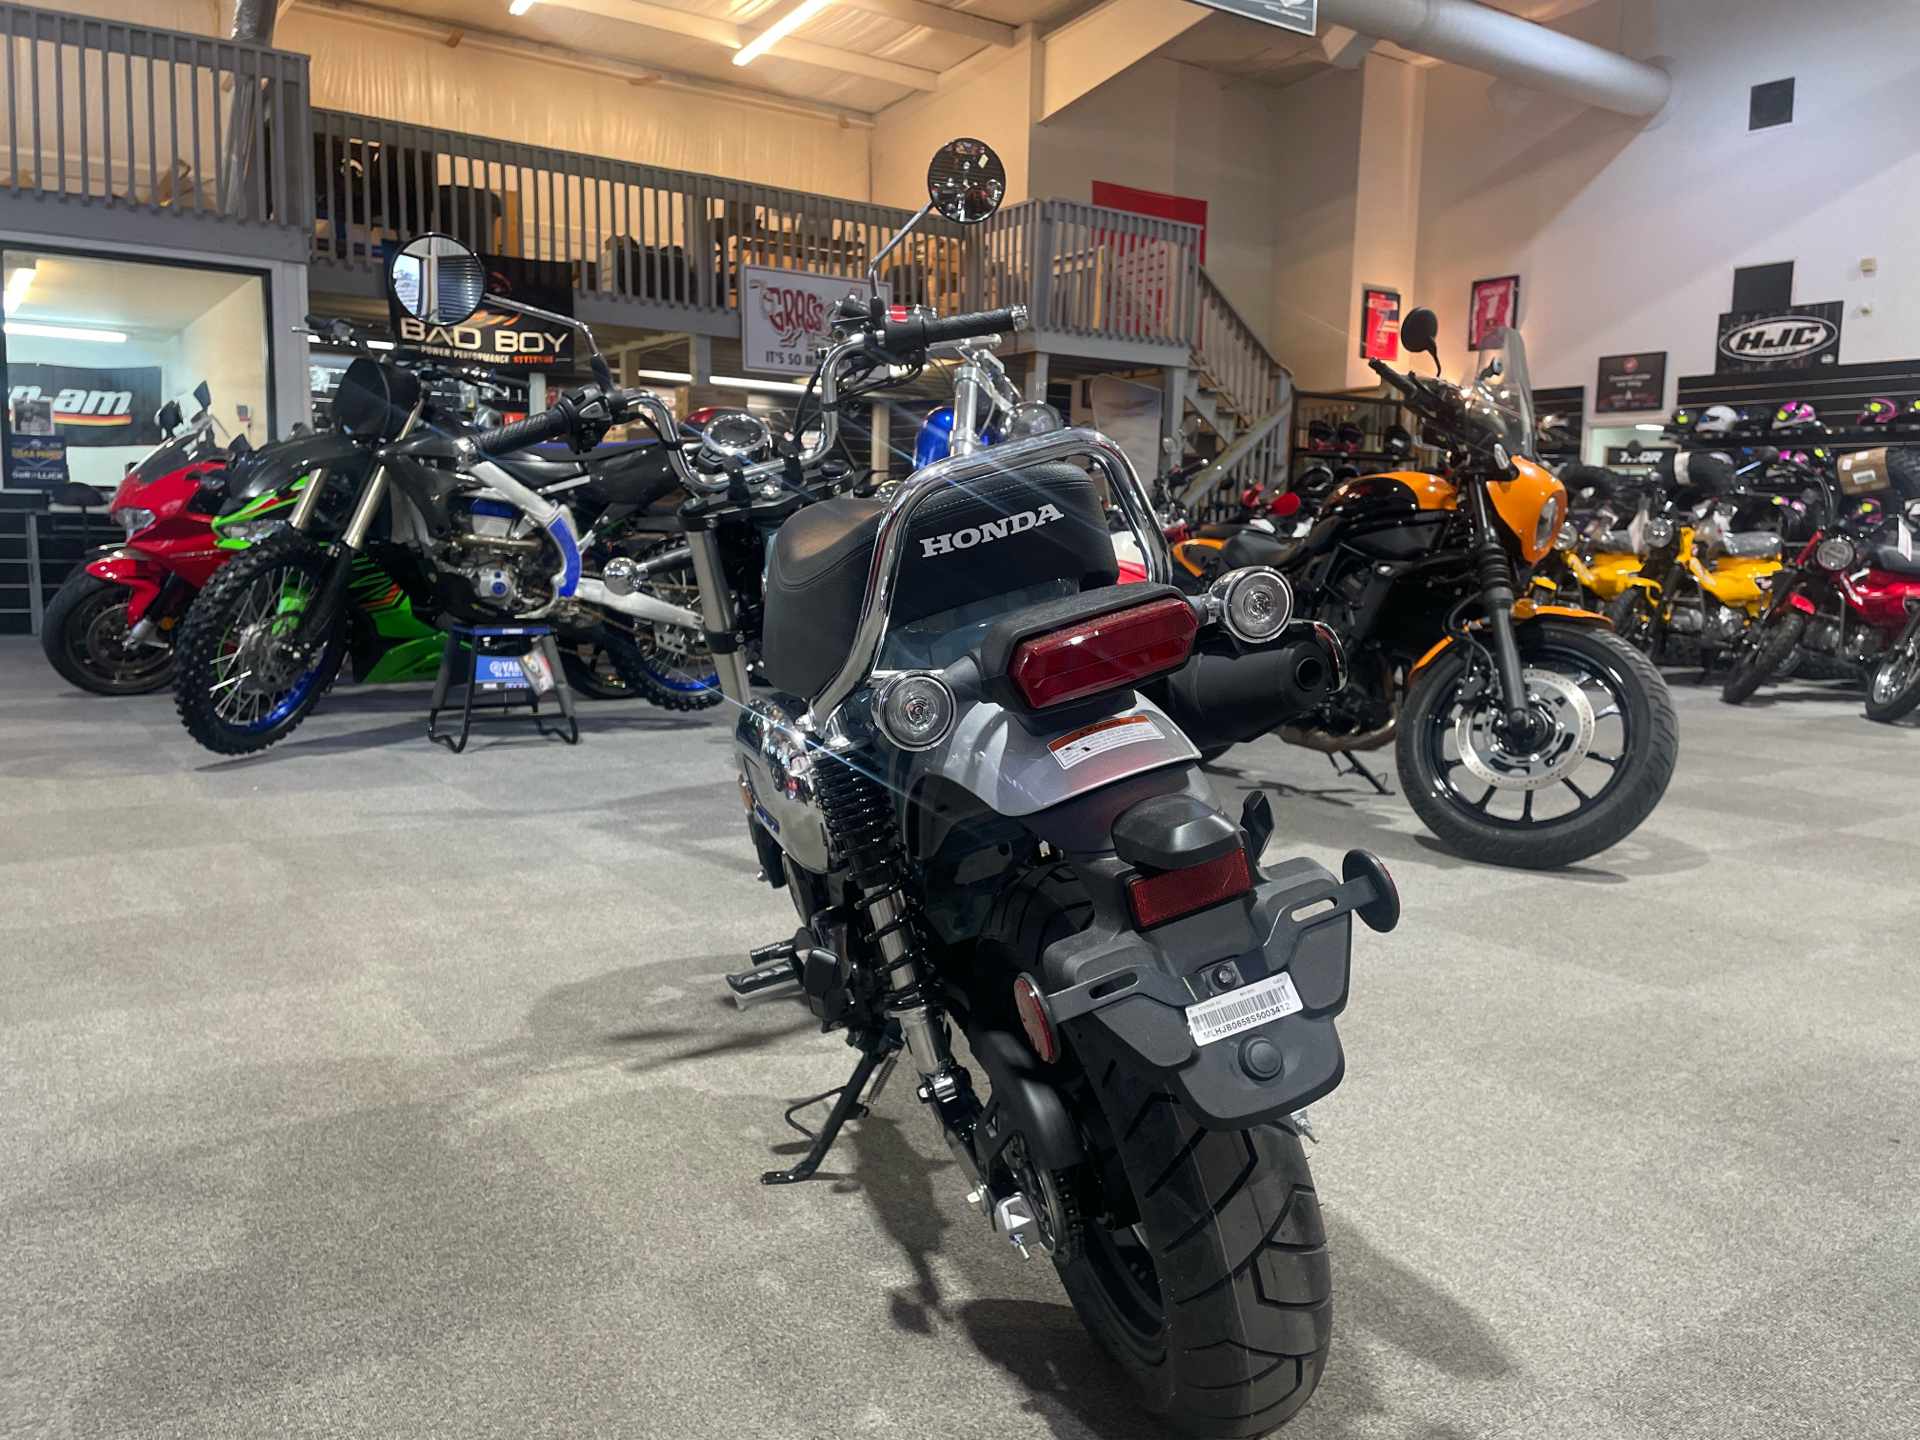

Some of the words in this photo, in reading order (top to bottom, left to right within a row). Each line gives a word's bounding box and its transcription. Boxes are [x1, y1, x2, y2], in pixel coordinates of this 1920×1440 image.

[400, 317, 482, 350] BAD
[494, 329, 569, 353] BOY
[1735, 326, 1823, 350] HJC
[420, 345, 450, 358] POWER
[453, 350, 510, 364] PERFORMANCE
[766, 351, 785, 365] IT'S
[788, 353, 802, 366] SO
[919, 503, 1065, 558] HONDA
[1203, 1002, 1292, 1039] MLHJB0658S5003412
